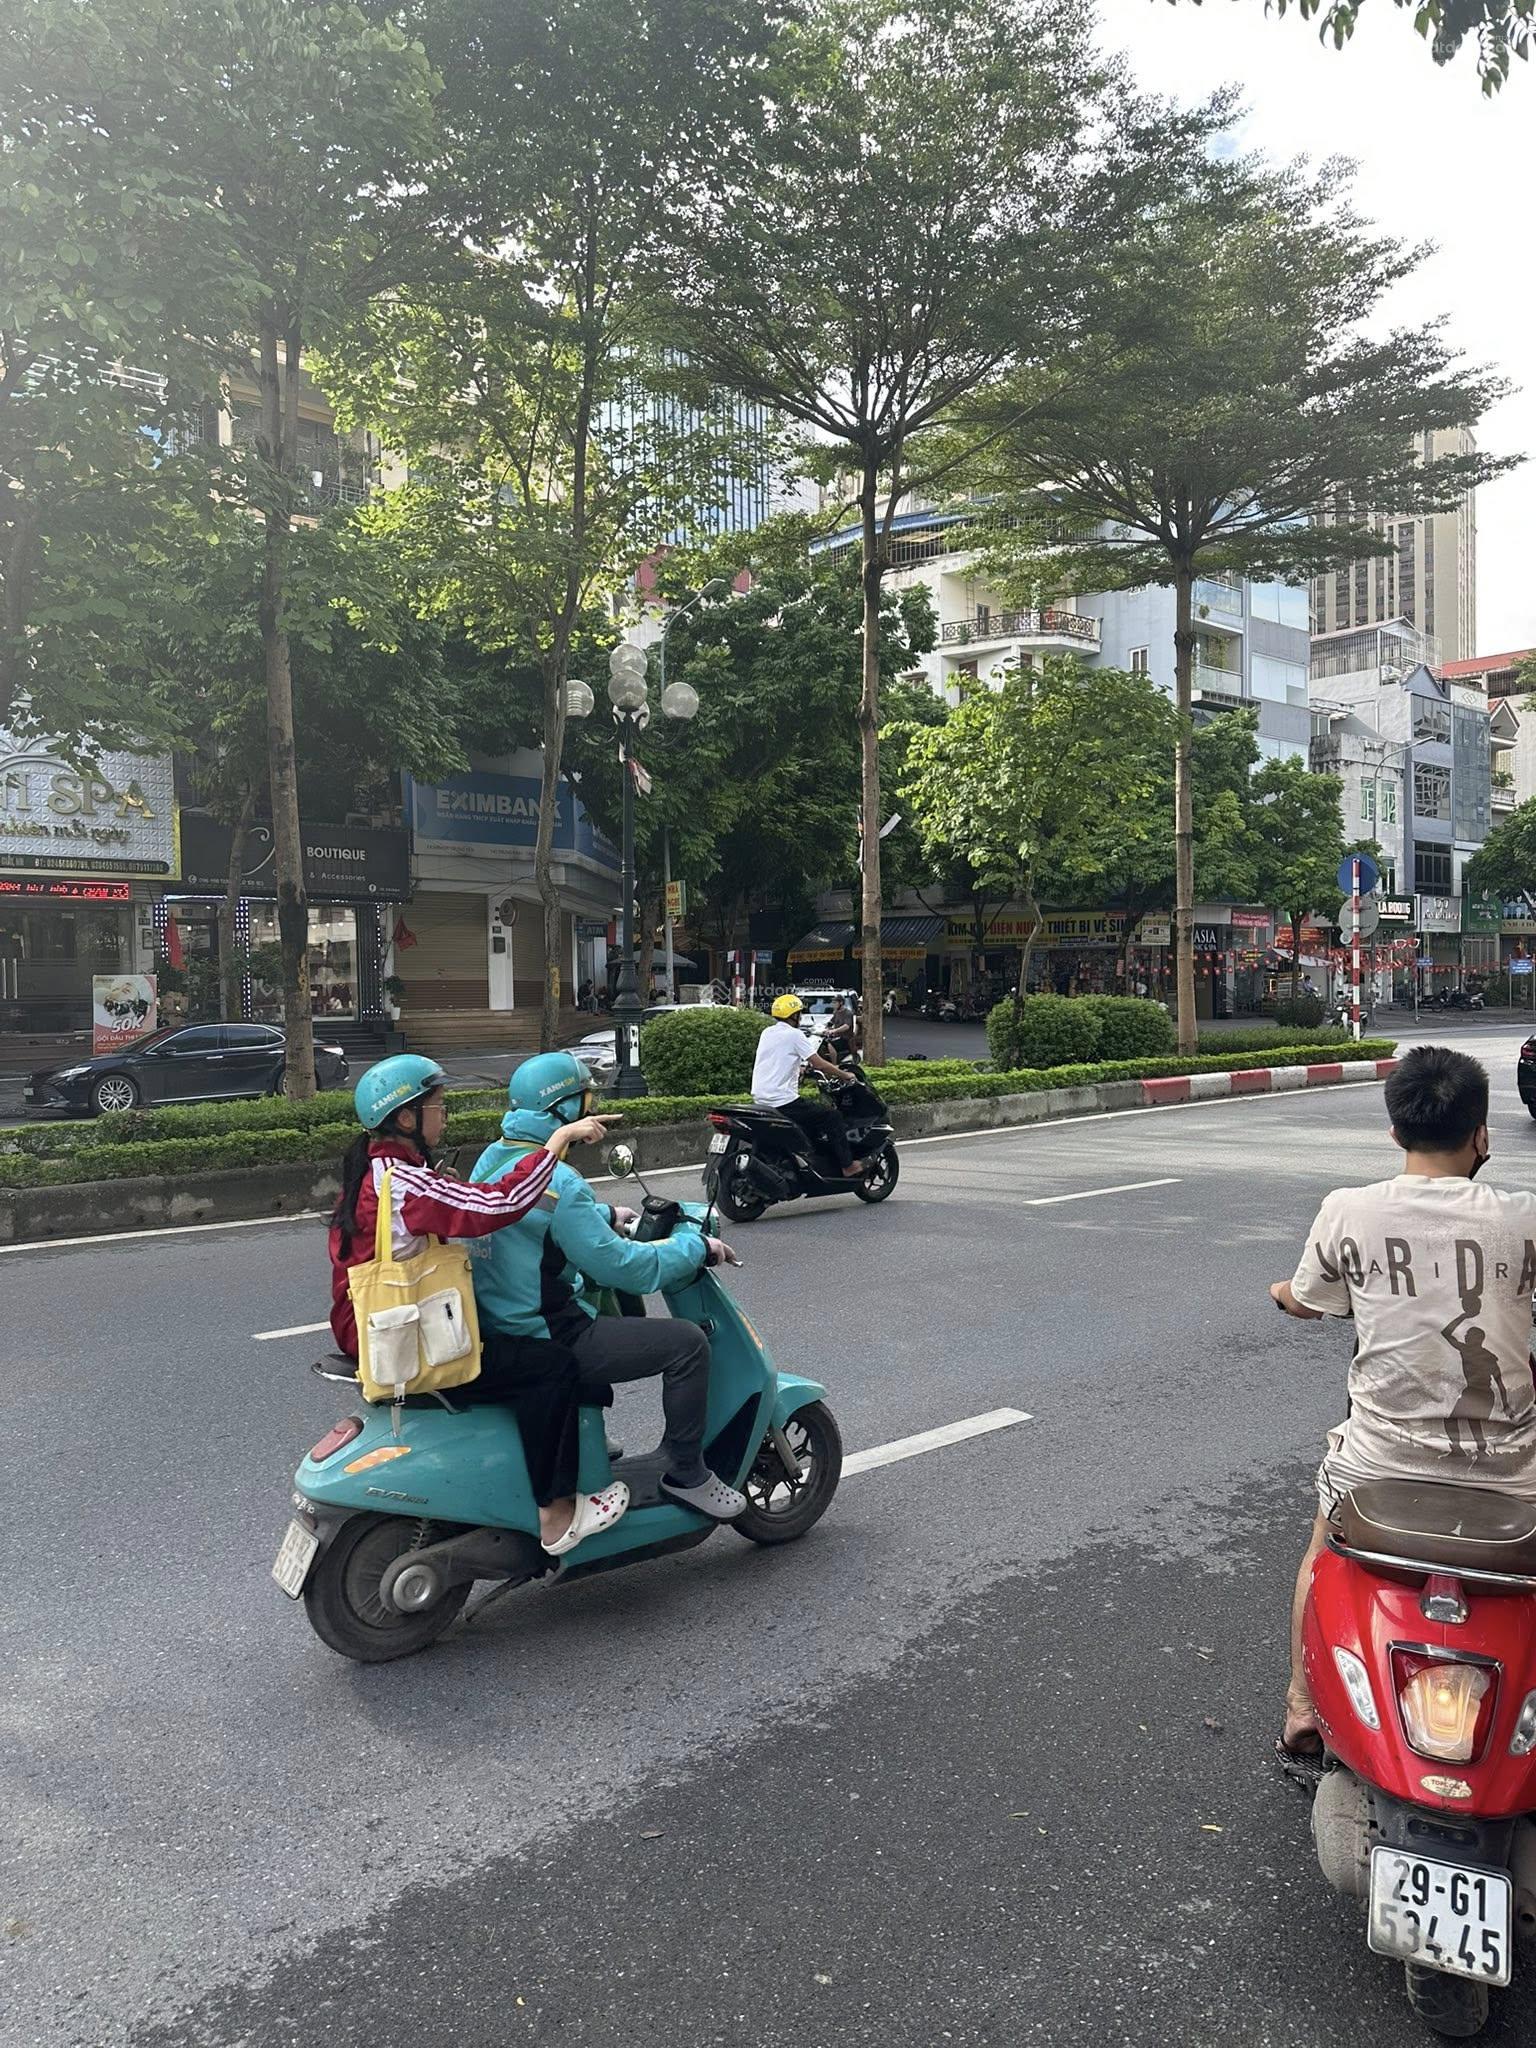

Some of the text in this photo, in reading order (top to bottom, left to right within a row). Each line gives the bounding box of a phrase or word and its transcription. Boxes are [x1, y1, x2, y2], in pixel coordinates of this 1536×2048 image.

[48, 773, 155, 819] SPA
[306, 846, 366, 861] BOUTIQUE
[321, 871, 366, 882] Accessories
[1047, 916, 1077, 934] THIẾT
[1193, 929, 1217, 943] ASIA
[111, 1014, 145, 1033] 50K
[1392, 1859, 1486, 1922] 29-G1
[1380, 1903, 1501, 1975] 534.45
